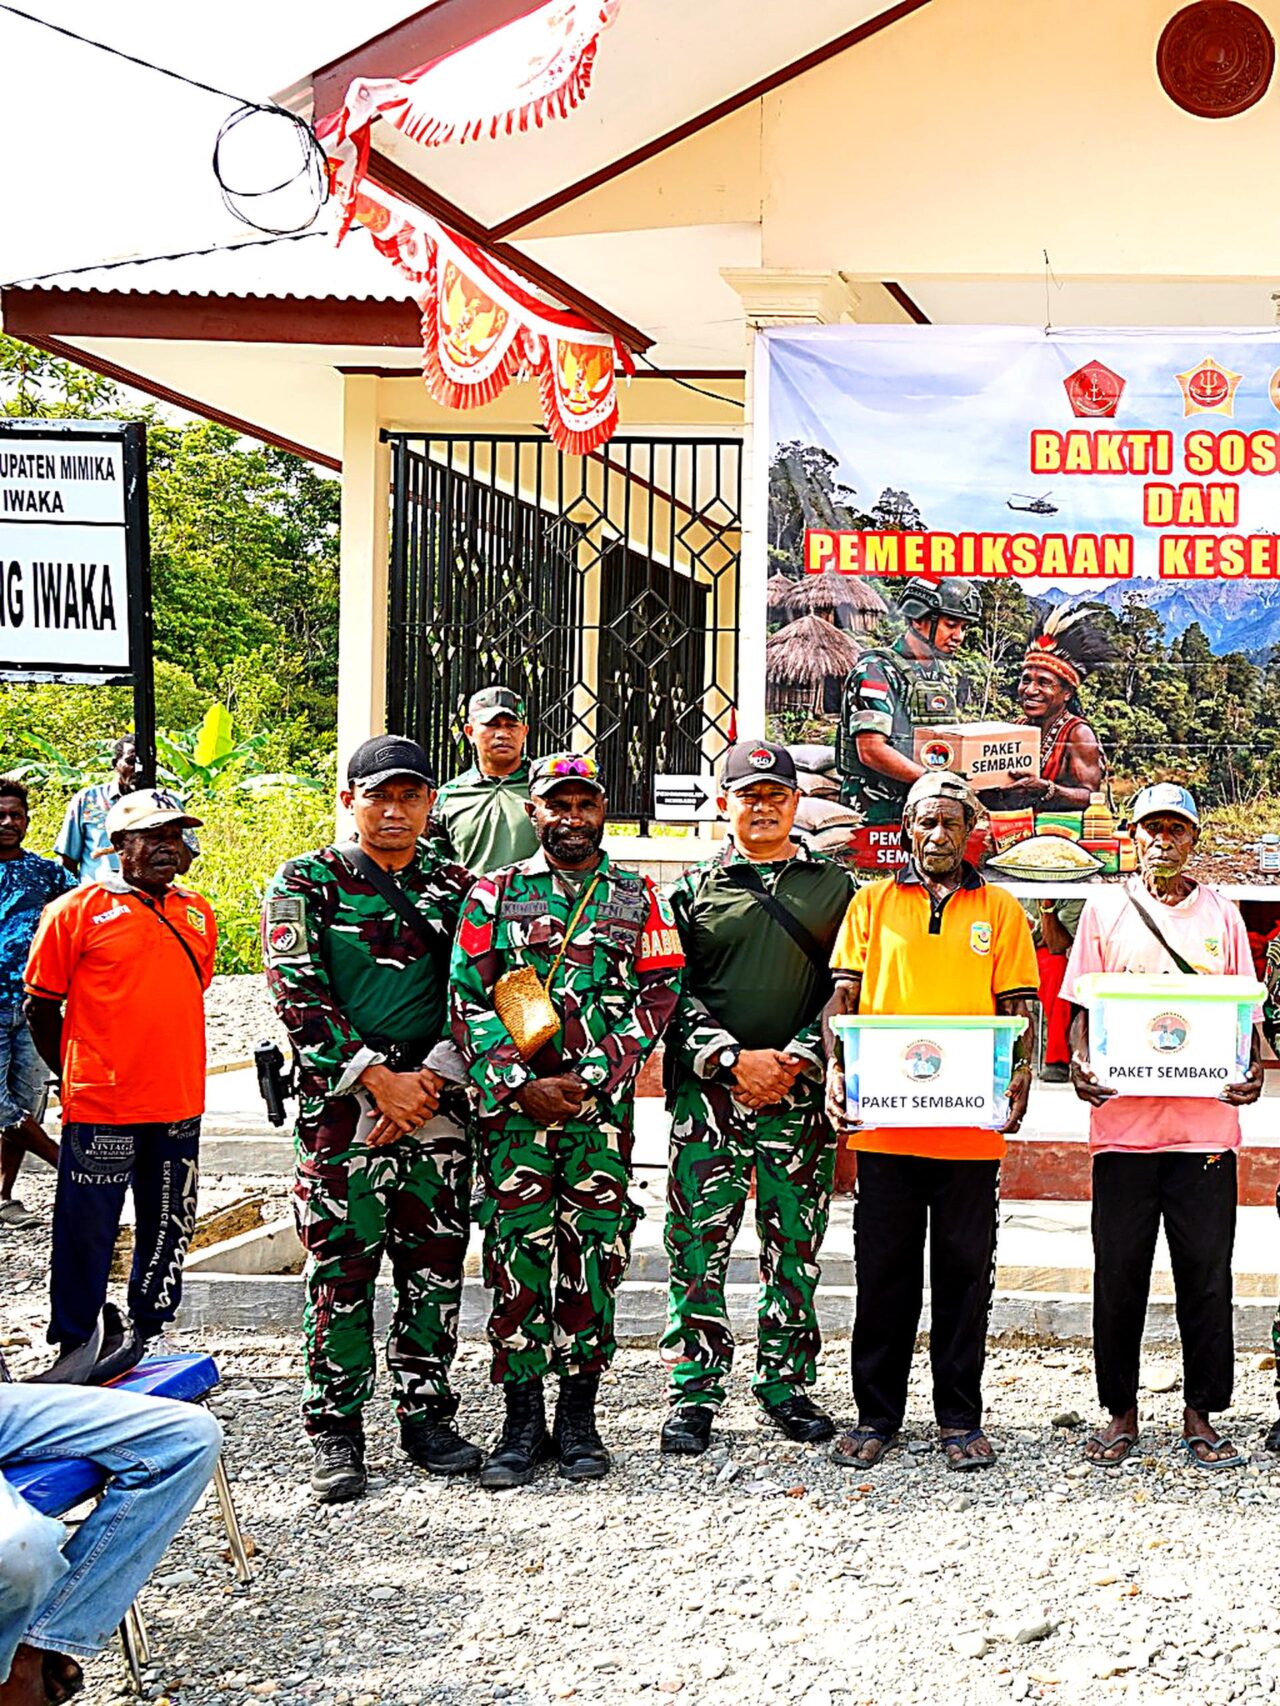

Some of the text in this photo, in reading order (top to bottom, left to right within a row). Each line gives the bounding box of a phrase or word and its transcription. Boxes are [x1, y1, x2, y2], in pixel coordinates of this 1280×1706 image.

[0, 453, 116, 481] UPATEN MIMIKA
[1033, 432, 1171, 474] BAKTI
[3, 489, 65, 513] IWAKA
[1146, 486, 1237, 525] DAN
[807, 533, 1132, 576] PEMERIKSAAN
[32, 562, 117, 631] IWAKA
[982, 741, 1023, 757] PAKET
[971, 755, 1033, 773] SEMBAKO
[1109, 1066, 1229, 1079] PAKET SEMBAKO
[861, 1095, 985, 1109] PAKET SEMBAKO
[149, 1229, 166, 1268] NAVAL
